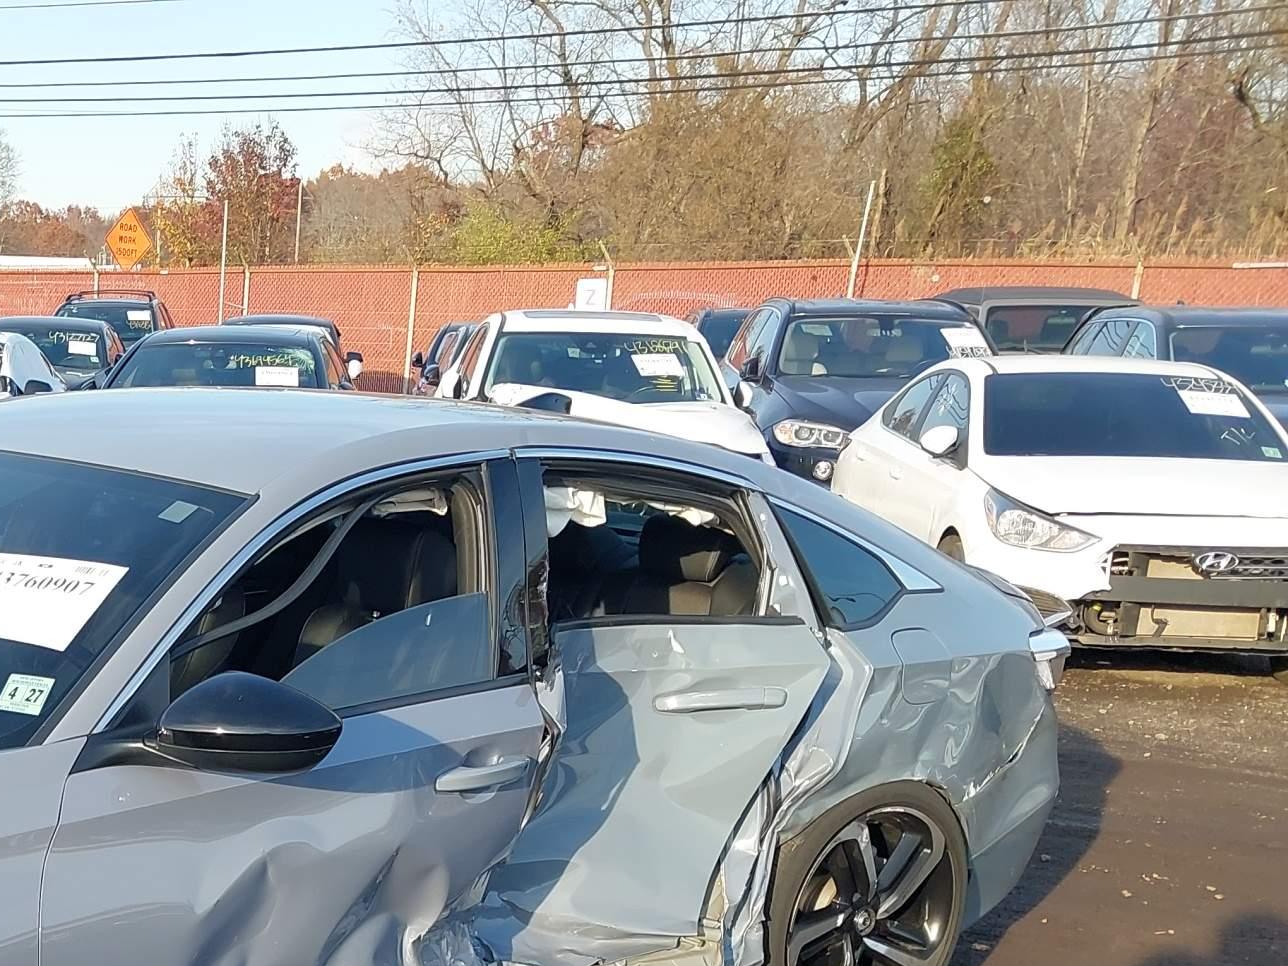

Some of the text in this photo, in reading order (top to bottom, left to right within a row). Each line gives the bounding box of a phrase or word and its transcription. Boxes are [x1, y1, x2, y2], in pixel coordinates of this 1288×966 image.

[119, 222, 137, 233] ROAD
[118, 234, 137, 246] WORK
[583, 289, 599, 305] Z
[8, 686, 45, 703] 4 27
